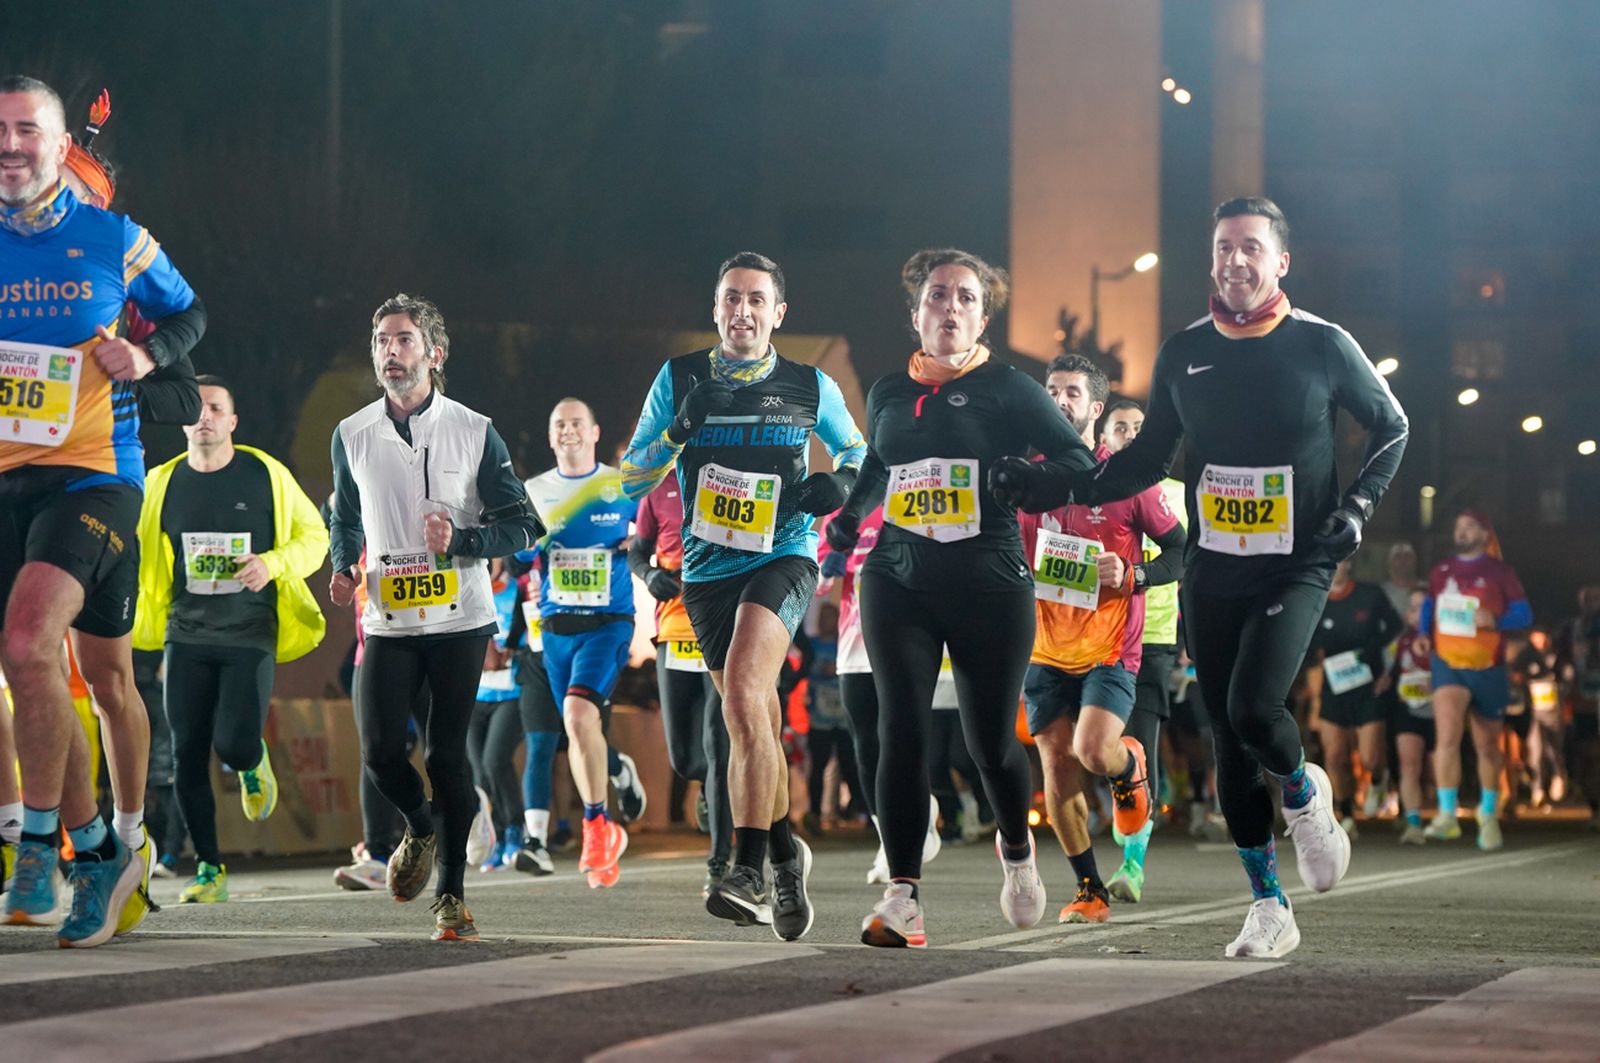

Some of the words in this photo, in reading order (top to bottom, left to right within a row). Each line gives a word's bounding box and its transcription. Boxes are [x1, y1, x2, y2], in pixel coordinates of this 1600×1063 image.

[27, 355, 40, 366] DE
[0, 378, 46, 410] 516
[764, 415, 793, 424] BAENA
[930, 467, 942, 477] DE
[706, 480, 720, 493] SAN
[715, 475, 739, 488] NOCHE
[739, 481, 751, 489] DE
[898, 482, 912, 492] SAN
[1215, 476, 1241, 487] NOCHE
[1243, 477, 1254, 487] DE
[1207, 485, 1222, 494] SAN
[713, 495, 755, 523] 803
[903, 489, 960, 517] 2981
[1214, 497, 1274, 525] 2982
[1048, 540, 1070, 551] NOCHE
[392, 555, 417, 566] NOCHE
[418, 555, 429, 564] DE
[384, 566, 401, 577] SAN
[1045, 557, 1088, 584] 1907
[561, 569, 599, 587] 8861
[393, 573, 447, 601] 3759
